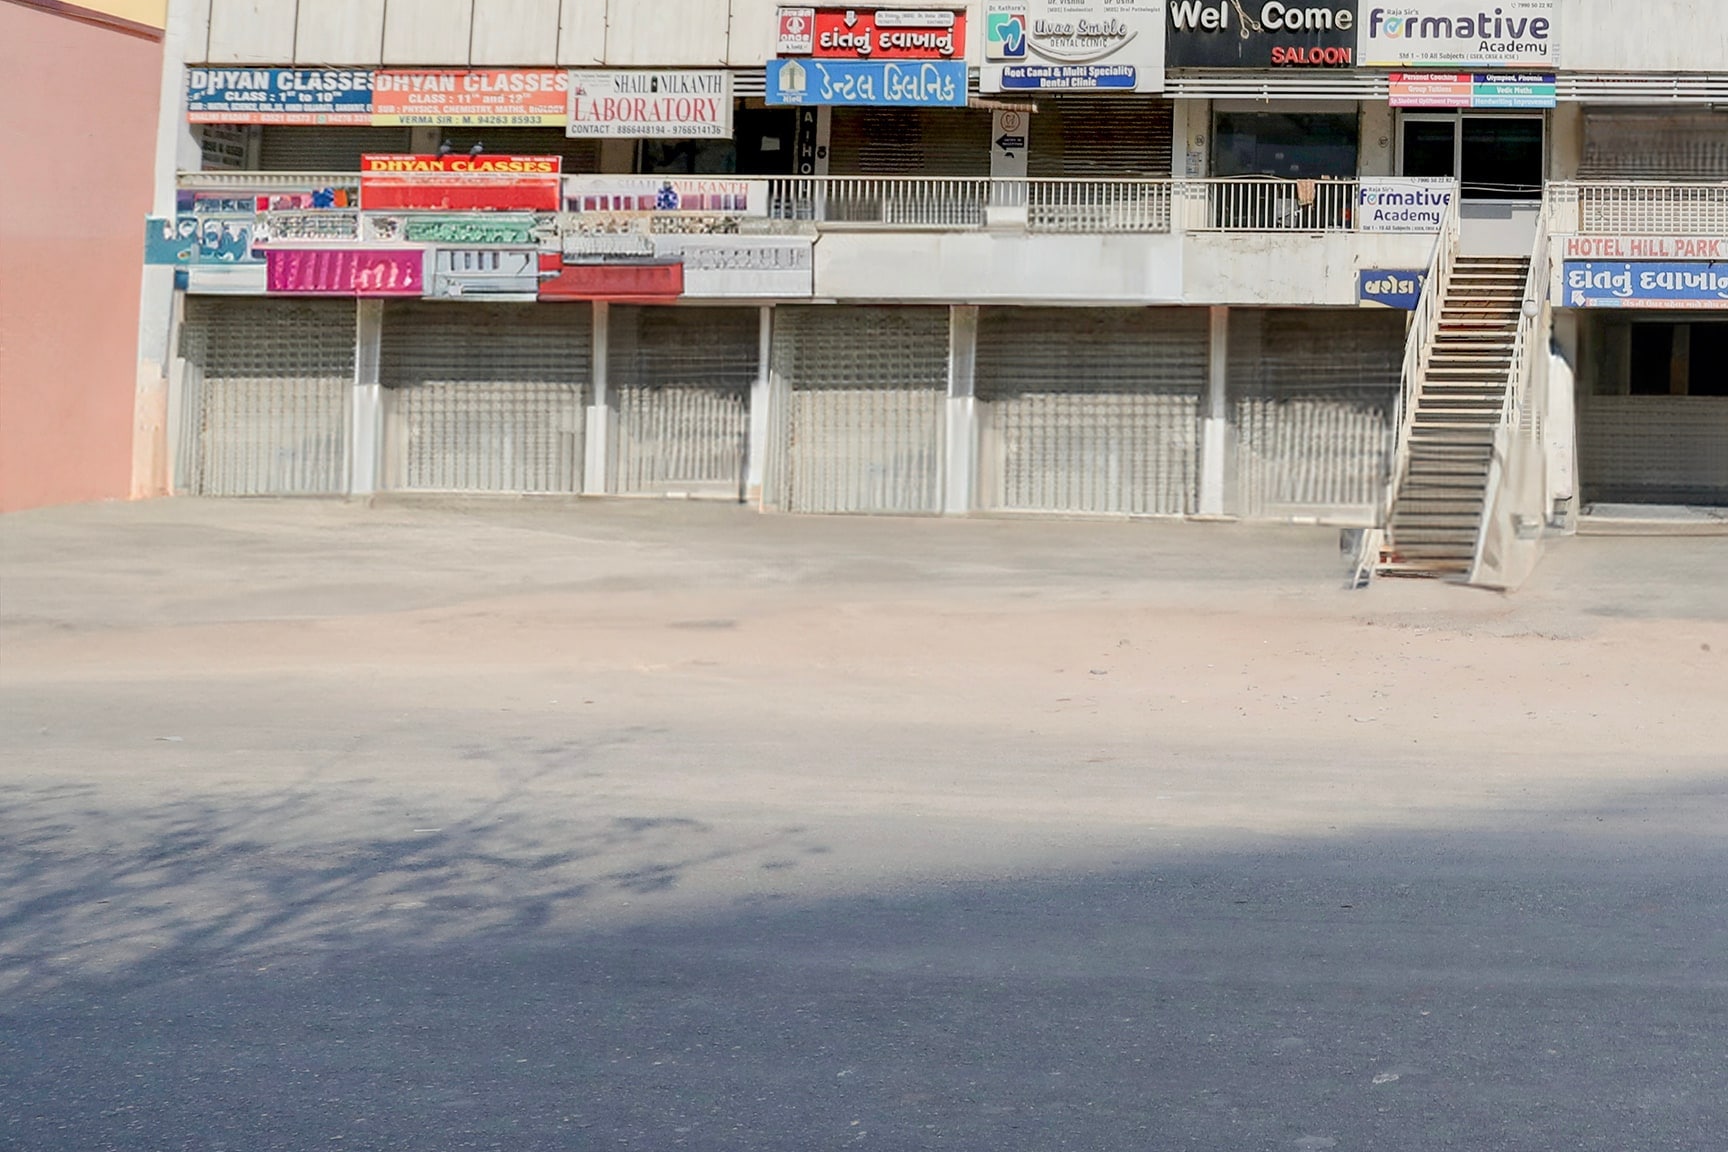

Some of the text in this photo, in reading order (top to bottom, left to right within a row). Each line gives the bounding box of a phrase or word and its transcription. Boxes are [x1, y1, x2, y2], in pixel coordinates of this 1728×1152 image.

[1170, 0, 1353, 30] Wel Come
[1370, 8, 1550, 39] formative
[1077, 19, 1127, 37] Smile
[820, 27, 954, 55] દાંતનું દવાખાનું
[1050, 38, 1108, 48] DENTAL CLINIC
[1479, 41, 1547, 55] Academy
[1272, 47, 1351, 64] SALOON
[191, 71, 269, 90] DHYAN
[815, 62, 875, 99] ડેન્ટલ
[1004, 67, 1133, 79] Root Canal & Multi Speciality
[376, 74, 454, 91] DHYAN
[464, 73, 568, 92] CLASSES
[614, 75, 648, 93] SHAIL
[660, 75, 722, 93] NILKANTH
[1040, 77, 1097, 87] Dental Clinic
[224, 92, 312, 102] CLASS to
[408, 94, 504, 103] CLASS and
[574, 98, 721, 122] LABORATORY
[400, 116, 433, 124] VERMA
[436, 116, 453, 124] SIR
[572, 125, 610, 134] CONTACT
[371, 160, 552, 172] DHYAN CLASSES
[673, 181, 749, 194] NILKANTH
[1360, 188, 1450, 206] formative
[1374, 209, 1440, 224] Academy
[1567, 238, 1721, 257] HOTEL HILL PARK
[1568, 263, 1634, 297] દાંતનું
